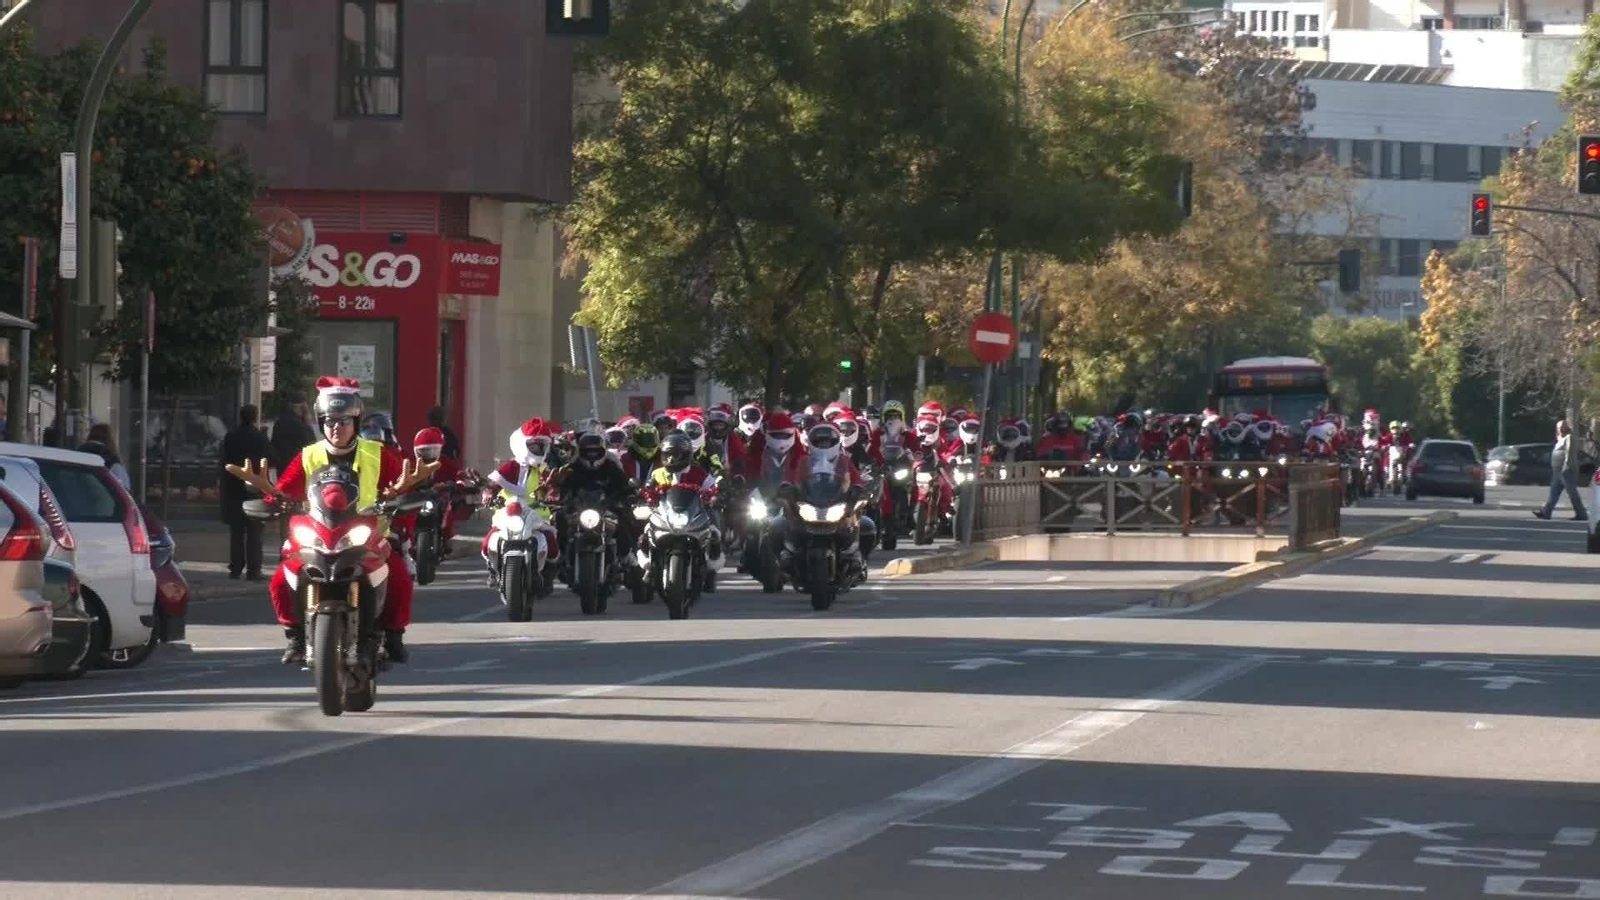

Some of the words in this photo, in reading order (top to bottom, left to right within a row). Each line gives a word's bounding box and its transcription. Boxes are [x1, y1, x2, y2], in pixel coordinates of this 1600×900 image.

[1027, 802, 1598, 846] TAXI
[1049, 826, 1548, 869] BUS
[908, 846, 1600, 898] SOLO
